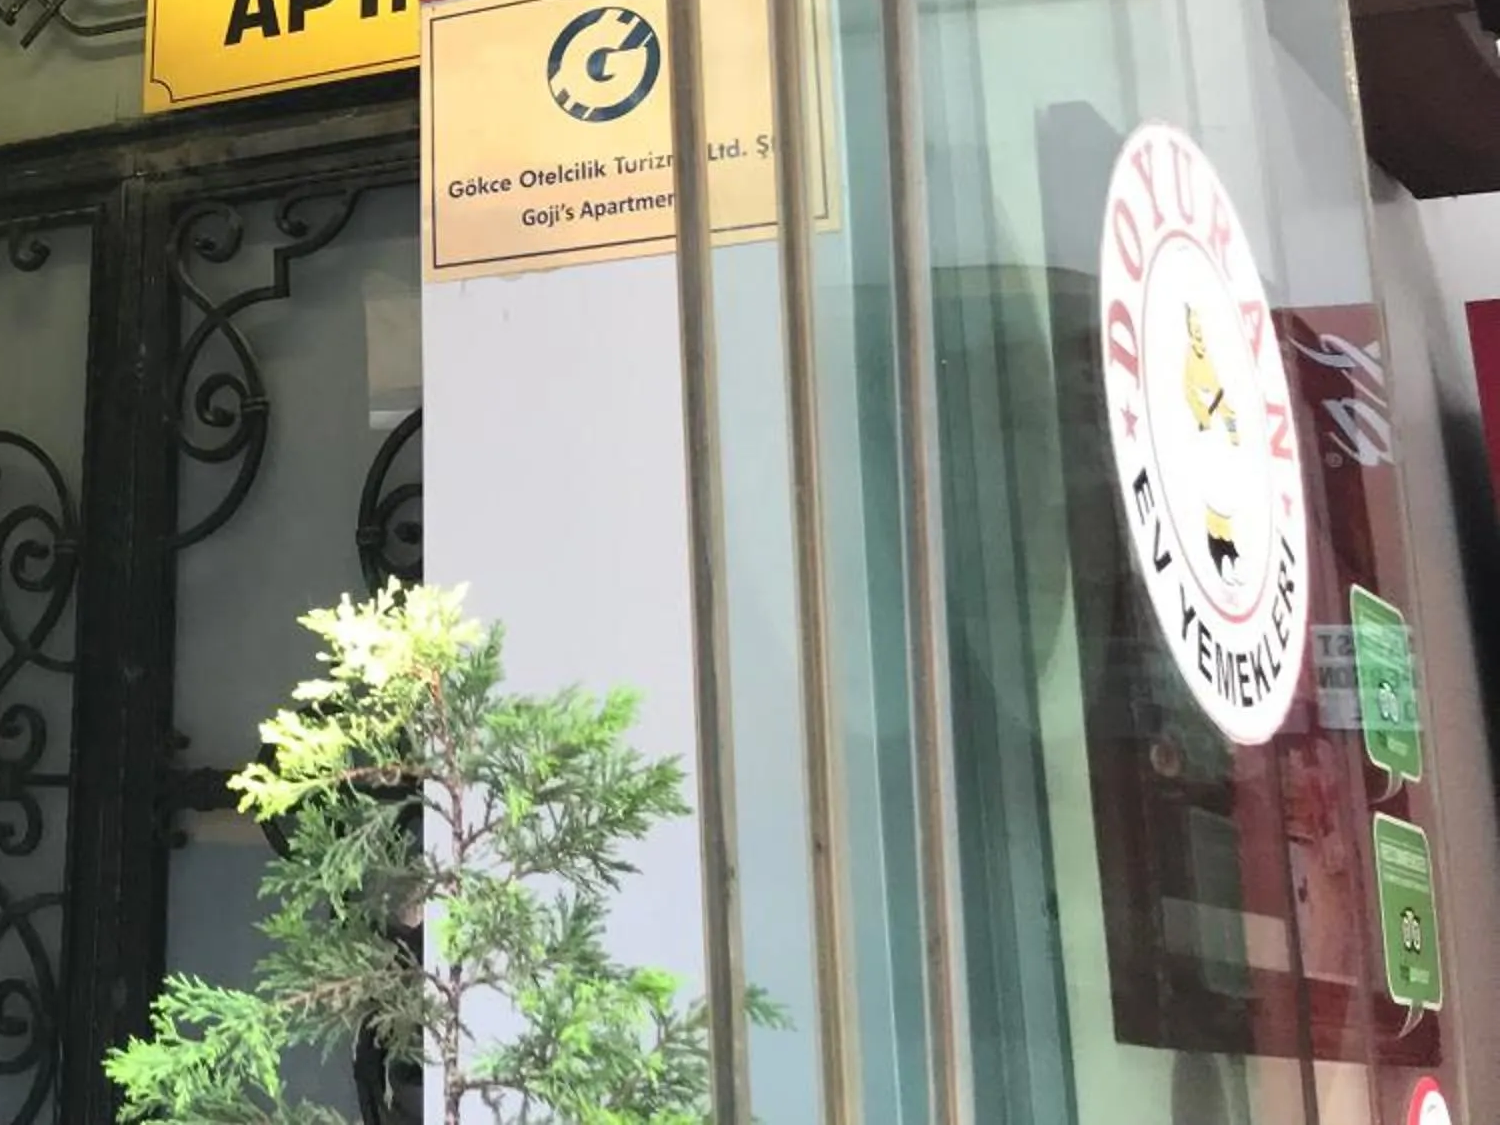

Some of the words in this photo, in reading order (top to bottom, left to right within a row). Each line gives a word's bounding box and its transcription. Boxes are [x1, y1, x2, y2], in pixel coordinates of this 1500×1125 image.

[518, 161, 608, 188] Otelcilik
[706, 139, 748, 162] Ltd.
[522, 202, 576, 228] Goji's
[1107, 137, 1295, 463] DOYURAN
[1132, 466, 1173, 573] EV
